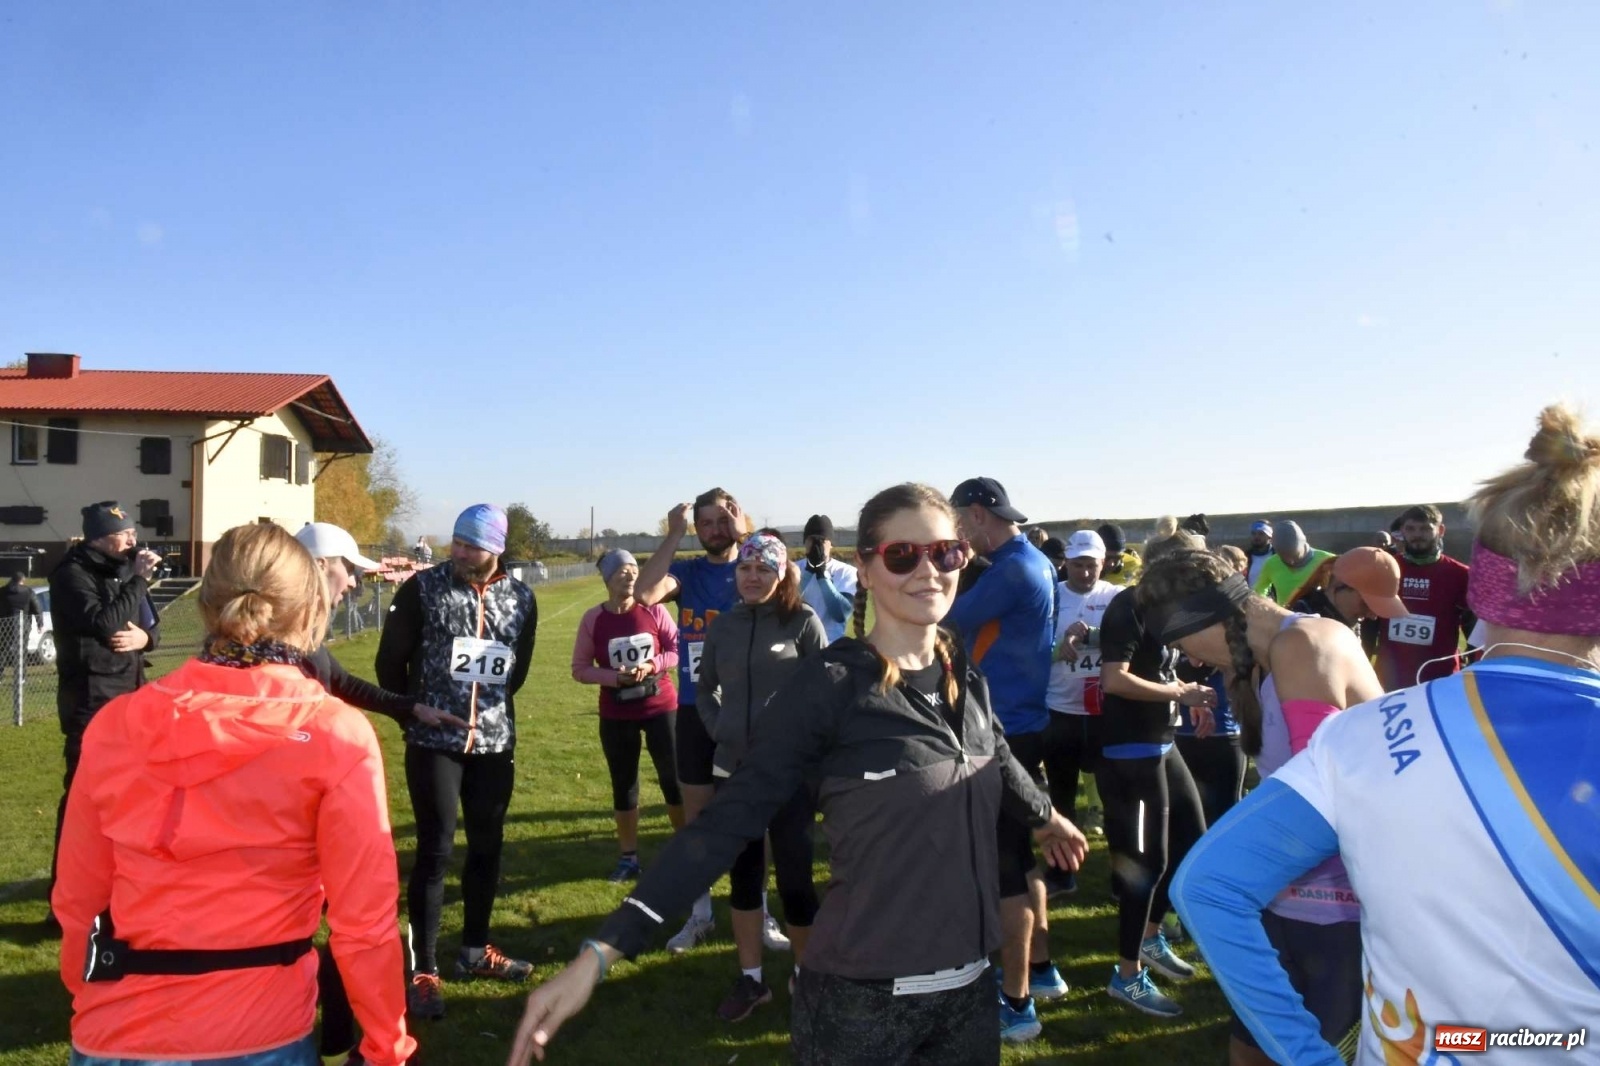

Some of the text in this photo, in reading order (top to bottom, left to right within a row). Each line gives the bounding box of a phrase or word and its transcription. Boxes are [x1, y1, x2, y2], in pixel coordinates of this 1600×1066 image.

[1392, 622, 1431, 640] 159
[613, 644, 651, 663] 107
[454, 653, 506, 676] 218
